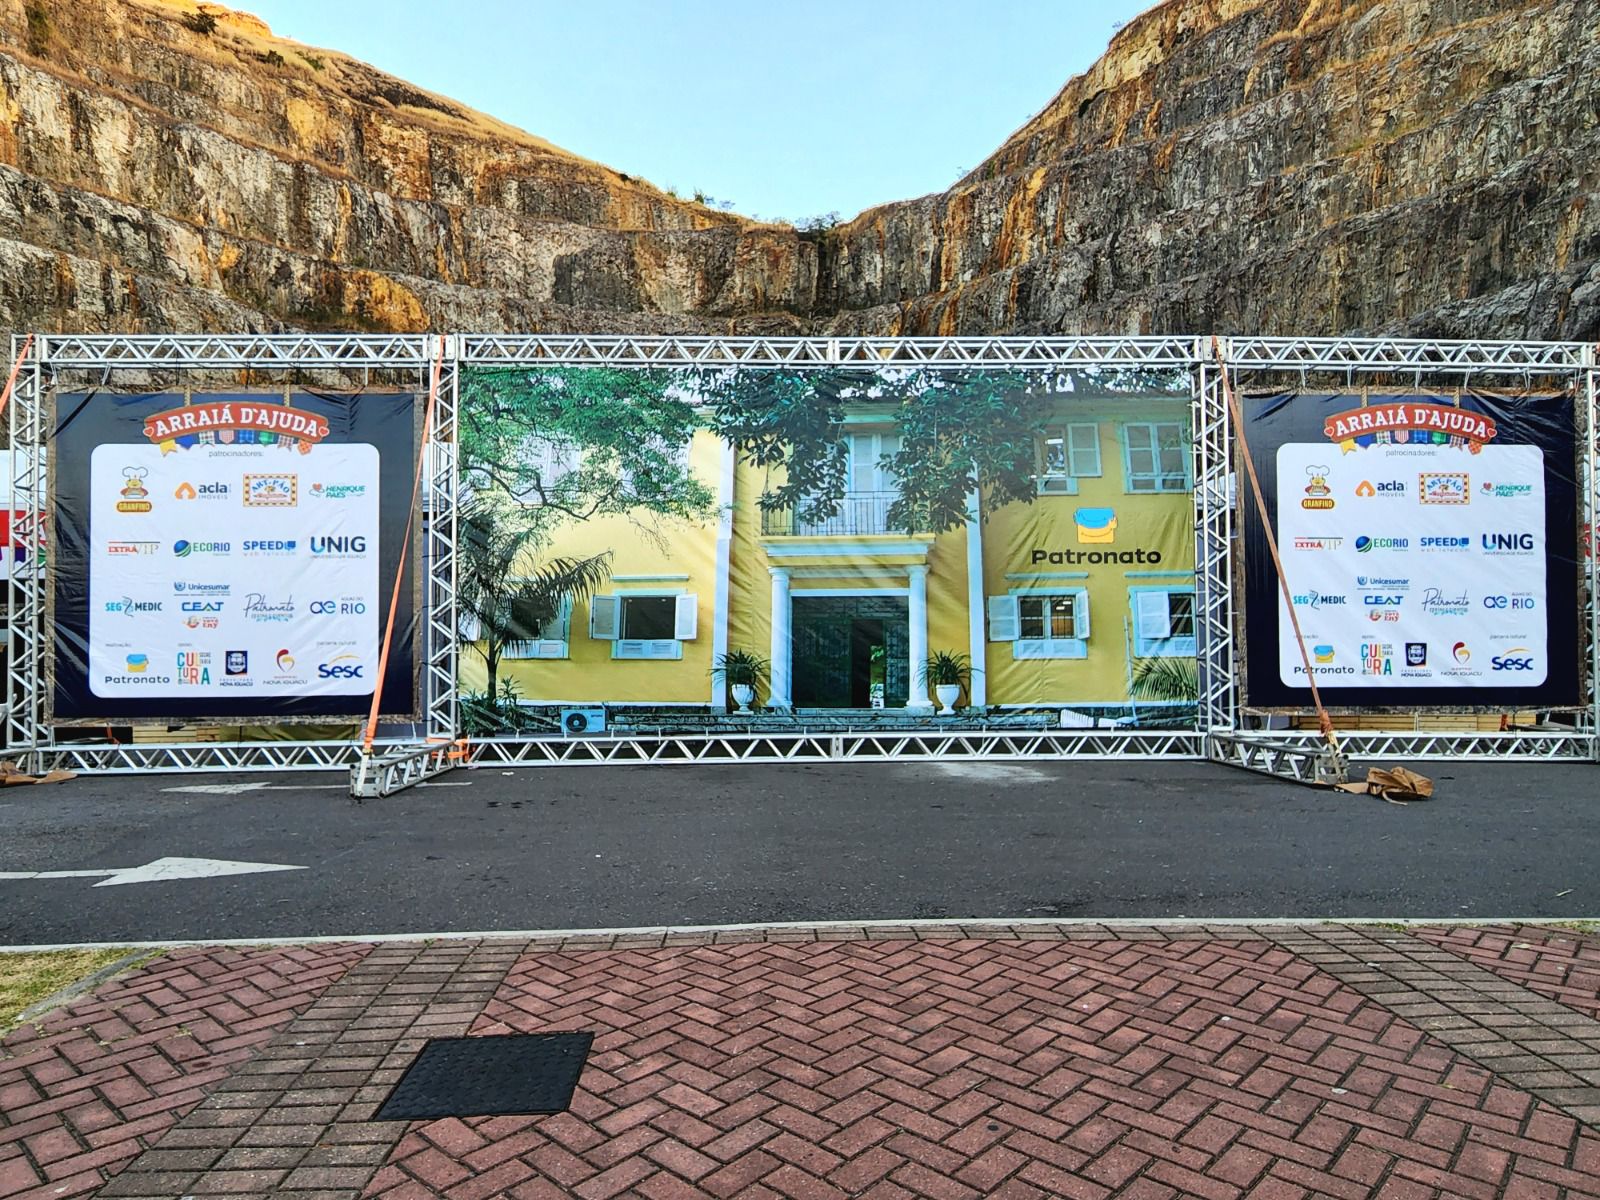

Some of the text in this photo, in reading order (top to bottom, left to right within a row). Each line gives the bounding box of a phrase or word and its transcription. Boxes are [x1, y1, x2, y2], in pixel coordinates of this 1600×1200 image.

[156, 404, 234, 437] ARRAIÁ
[1335, 405, 1409, 437] ARRAIÁ
[198, 482, 228, 494] acla
[1377, 480, 1405, 491] acla
[192, 542, 231, 552] ECORIO
[310, 536, 367, 553] UNIG
[1373, 538, 1409, 548] ECORIO
[1482, 533, 1534, 550] UNIG
[1031, 548, 1162, 565] Patronato
[1370, 577, 1410, 585] Unicesumar
[188, 583, 231, 591] Unicesumar
[1293, 595, 1347, 605] SEG MEDIC
[1364, 596, 1404, 605] CEAT
[1511, 598, 1535, 610] RIO
[105, 602, 163, 612] SEG MEDIC
[181, 602, 224, 612] CEAT
[341, 603, 366, 615] RIO
[1491, 656, 1534, 671] Sesc
[317, 663, 364, 678] Sesc
[104, 675, 170, 684] Patronato
